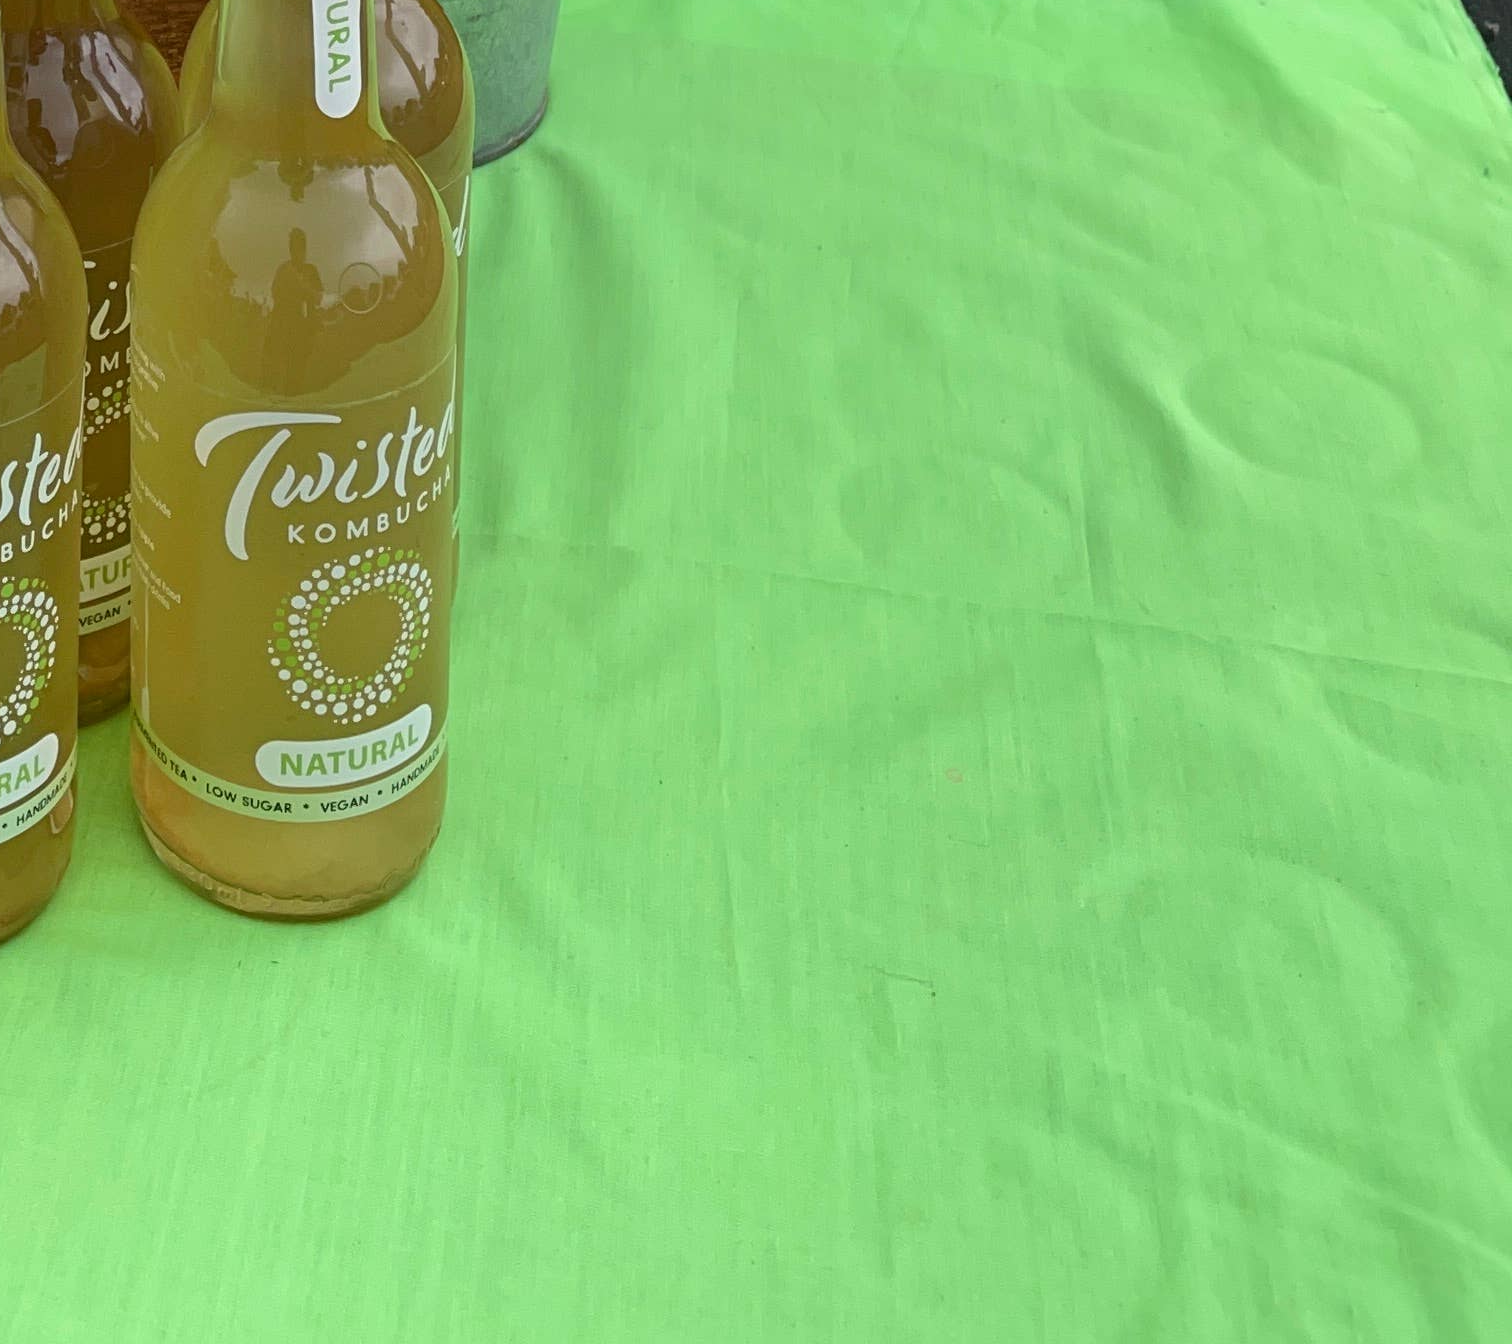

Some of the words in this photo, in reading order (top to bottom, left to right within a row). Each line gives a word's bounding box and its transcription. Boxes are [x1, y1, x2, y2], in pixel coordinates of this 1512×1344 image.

[195, 343, 457, 561] Twisted
[288, 464, 451, 546] KOMBUCHA
[280, 725, 420, 776] NATURAL
